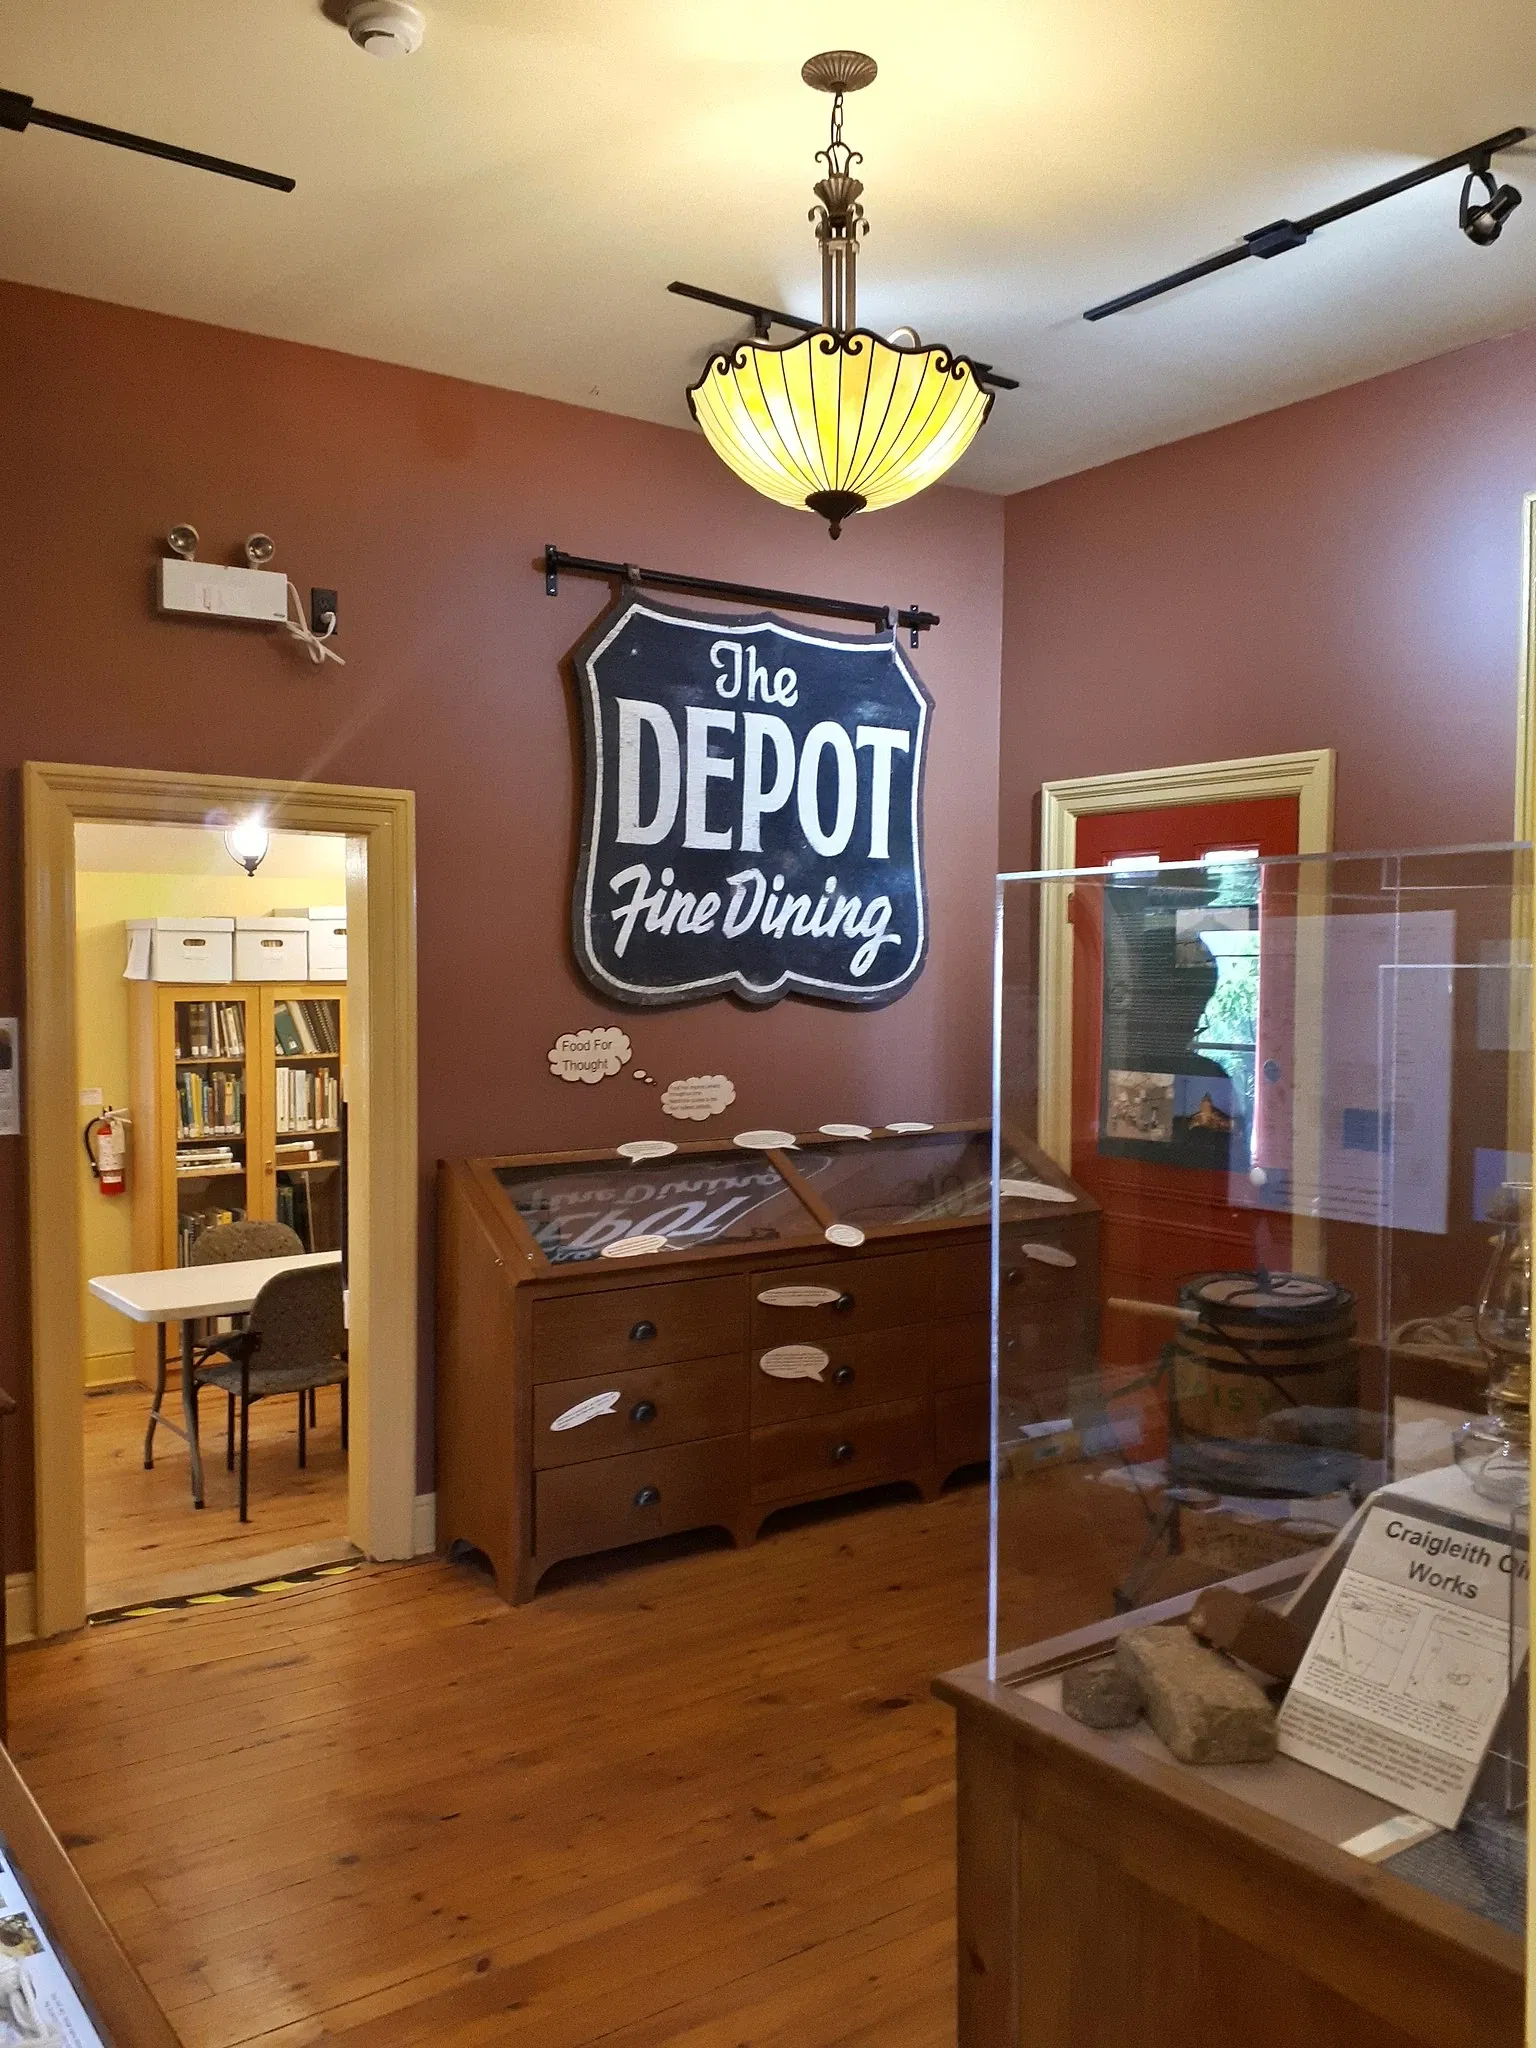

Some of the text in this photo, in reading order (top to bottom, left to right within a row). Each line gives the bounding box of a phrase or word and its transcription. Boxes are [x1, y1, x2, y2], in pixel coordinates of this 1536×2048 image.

[710, 640, 798, 707] The
[614, 697, 911, 859] DEPOT
[609, 864, 902, 978] Fine Dining
[562, 1039, 613, 1052] Food For
[562, 1058, 609, 1073] Thought
[1386, 1519, 1492, 1568] Craigleith
[1407, 1560, 1479, 1600] Works
